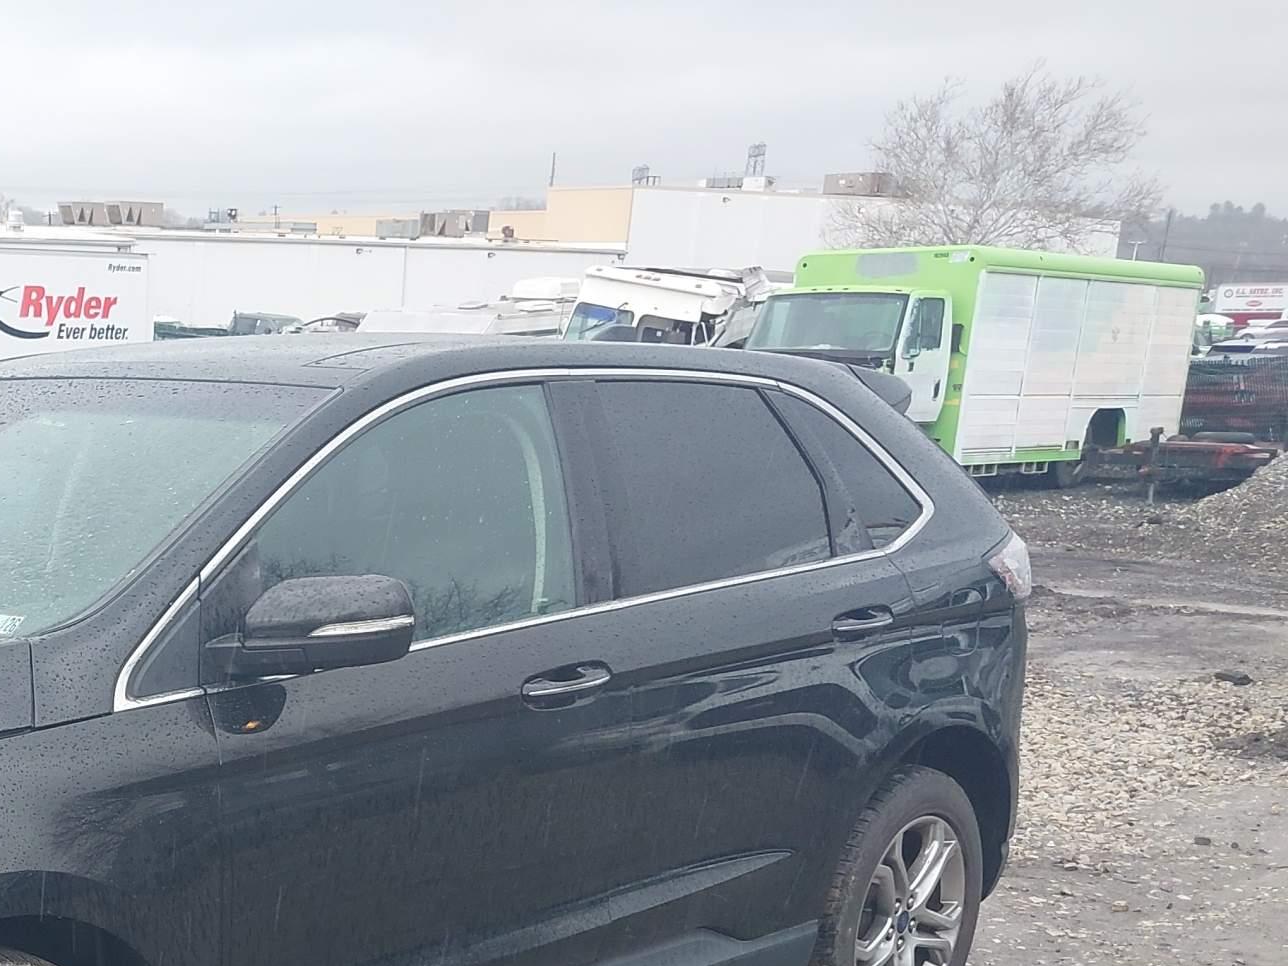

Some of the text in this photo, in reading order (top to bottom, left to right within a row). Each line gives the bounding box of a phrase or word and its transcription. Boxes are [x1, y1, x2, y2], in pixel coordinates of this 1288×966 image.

[108, 264, 141, 273] Ryder.com
[19, 285, 117, 326] Ryder
[56, 323, 128, 341] Ever better.
